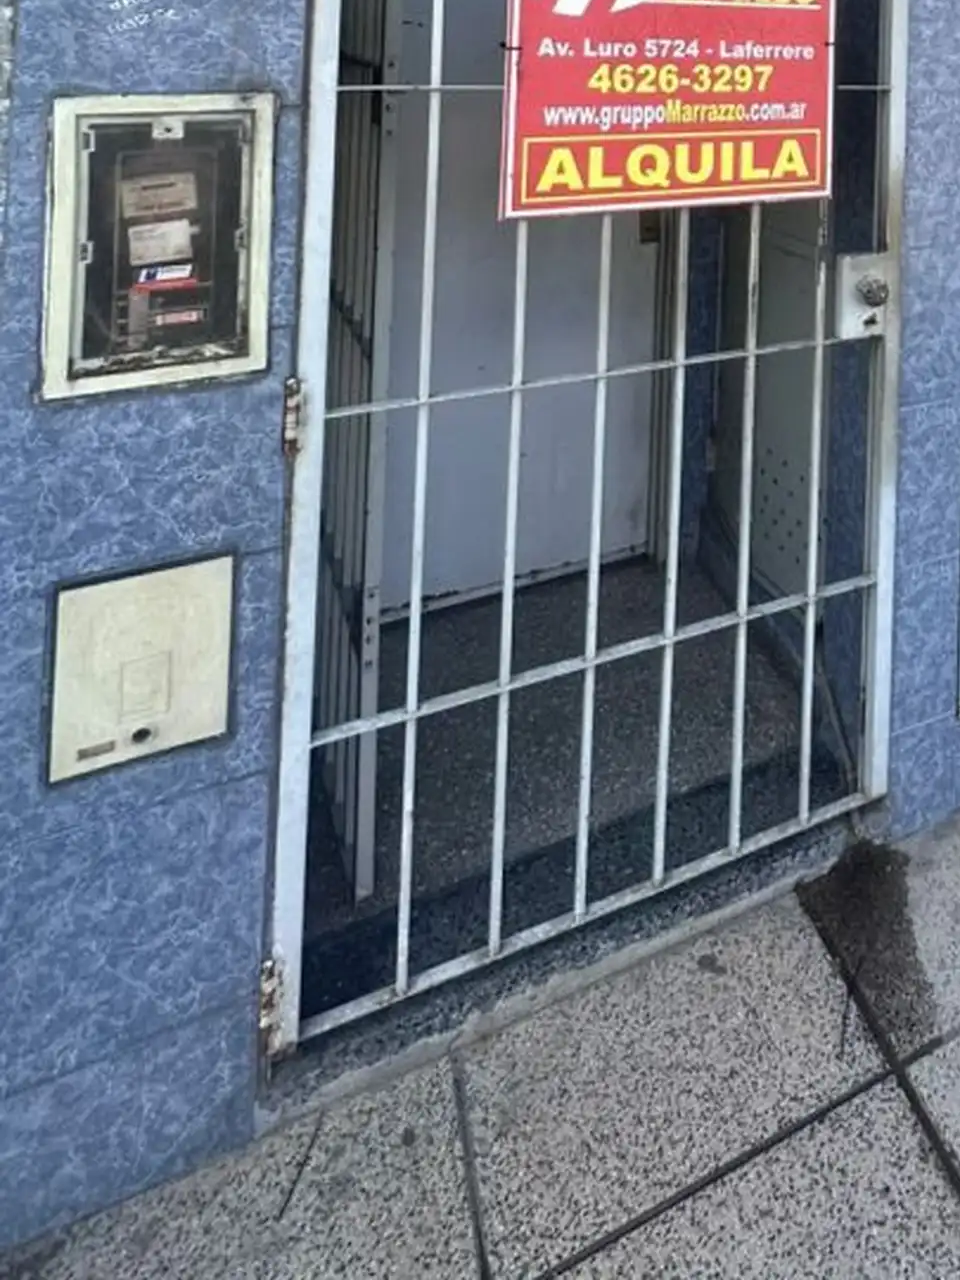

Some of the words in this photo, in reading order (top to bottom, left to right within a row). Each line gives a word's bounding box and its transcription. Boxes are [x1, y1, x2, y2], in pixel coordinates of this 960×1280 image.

[537, 38, 574, 57] Av.
[583, 39, 637, 57] Luro
[644, 39, 700, 58] 5724
[720, 40, 815, 60] Laferrere
[587, 64, 774, 93] 4626-3297
[535, 139, 809, 192] ALQUILA
